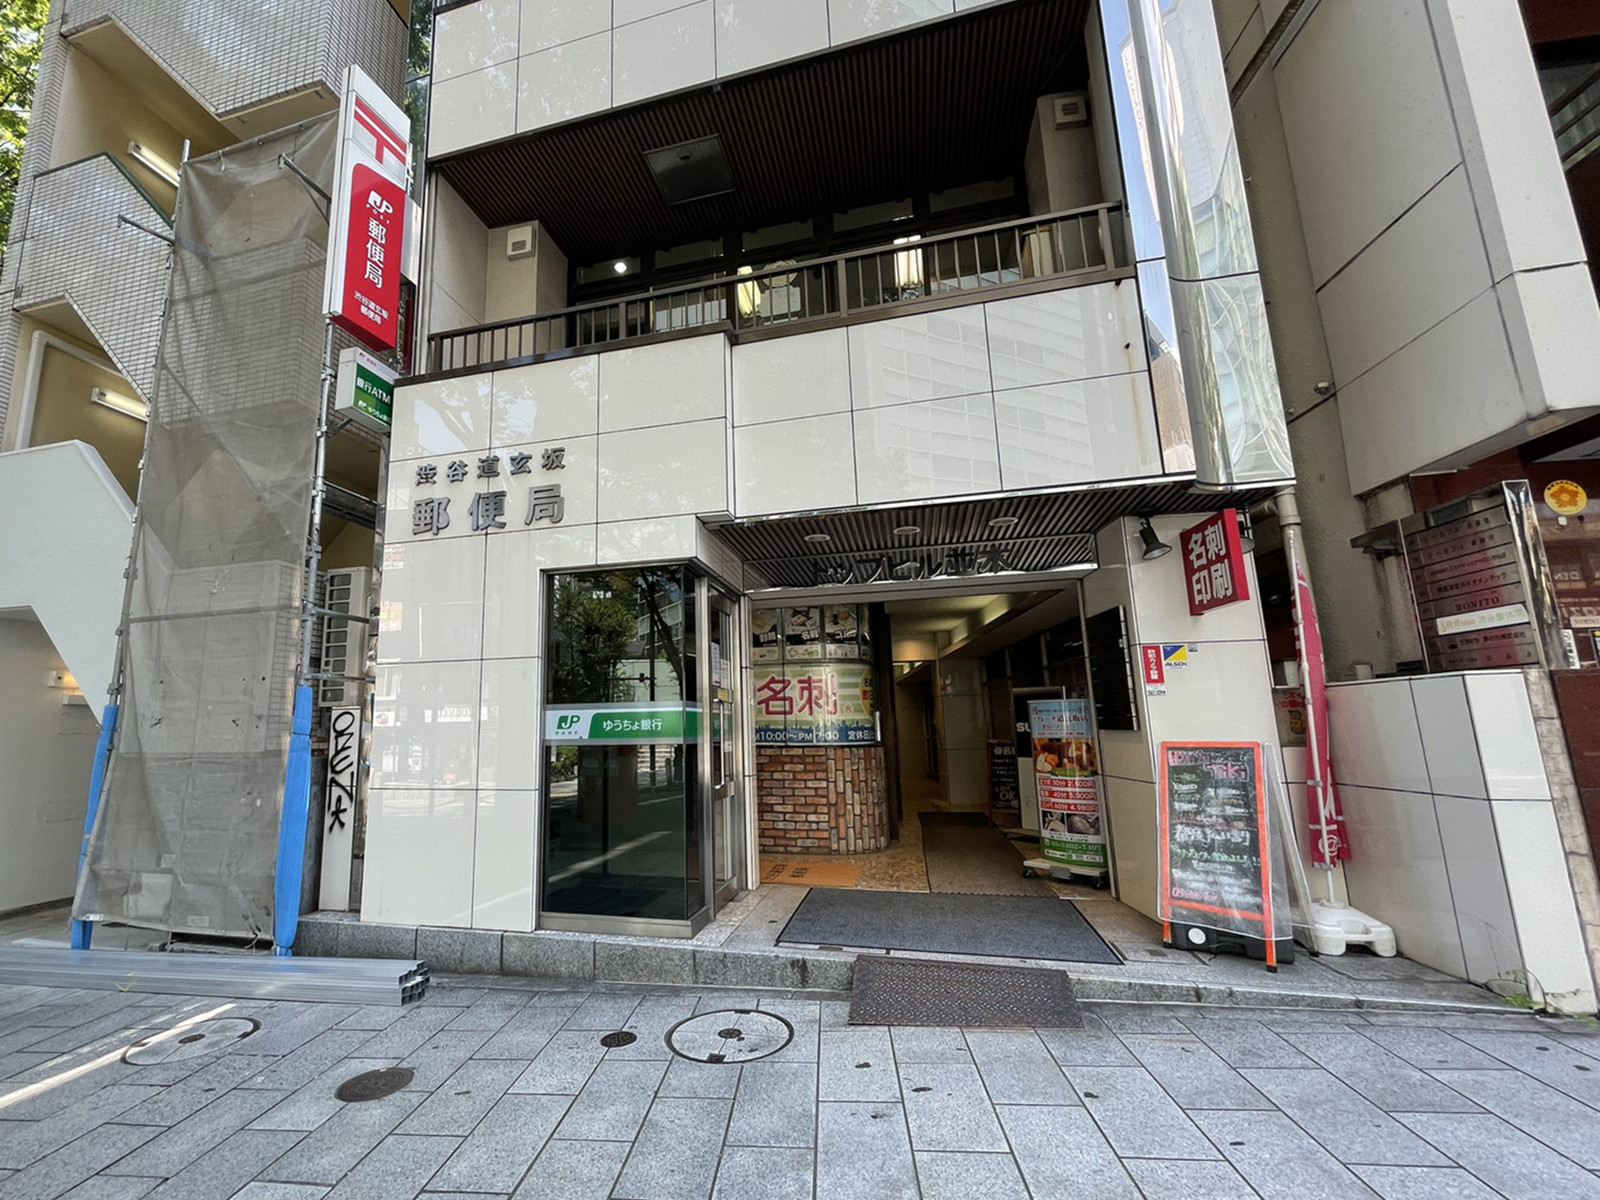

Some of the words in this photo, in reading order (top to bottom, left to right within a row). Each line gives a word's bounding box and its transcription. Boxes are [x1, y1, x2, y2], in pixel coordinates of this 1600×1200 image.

[364, 217, 386, 288] 郵便局
[416, 447, 566, 486] 渋谷道玄坂
[412, 484, 565, 536] 郵便局
[1188, 520, 1226, 569] 名刺
[1192, 559, 1233, 606] 印刷
[1455, 596, 1500, 612] BONITO
[757, 674, 838, 716] 名刺
[557, 714, 581, 730] JP
[602, 718, 662, 731] ゆうちょ銀行
